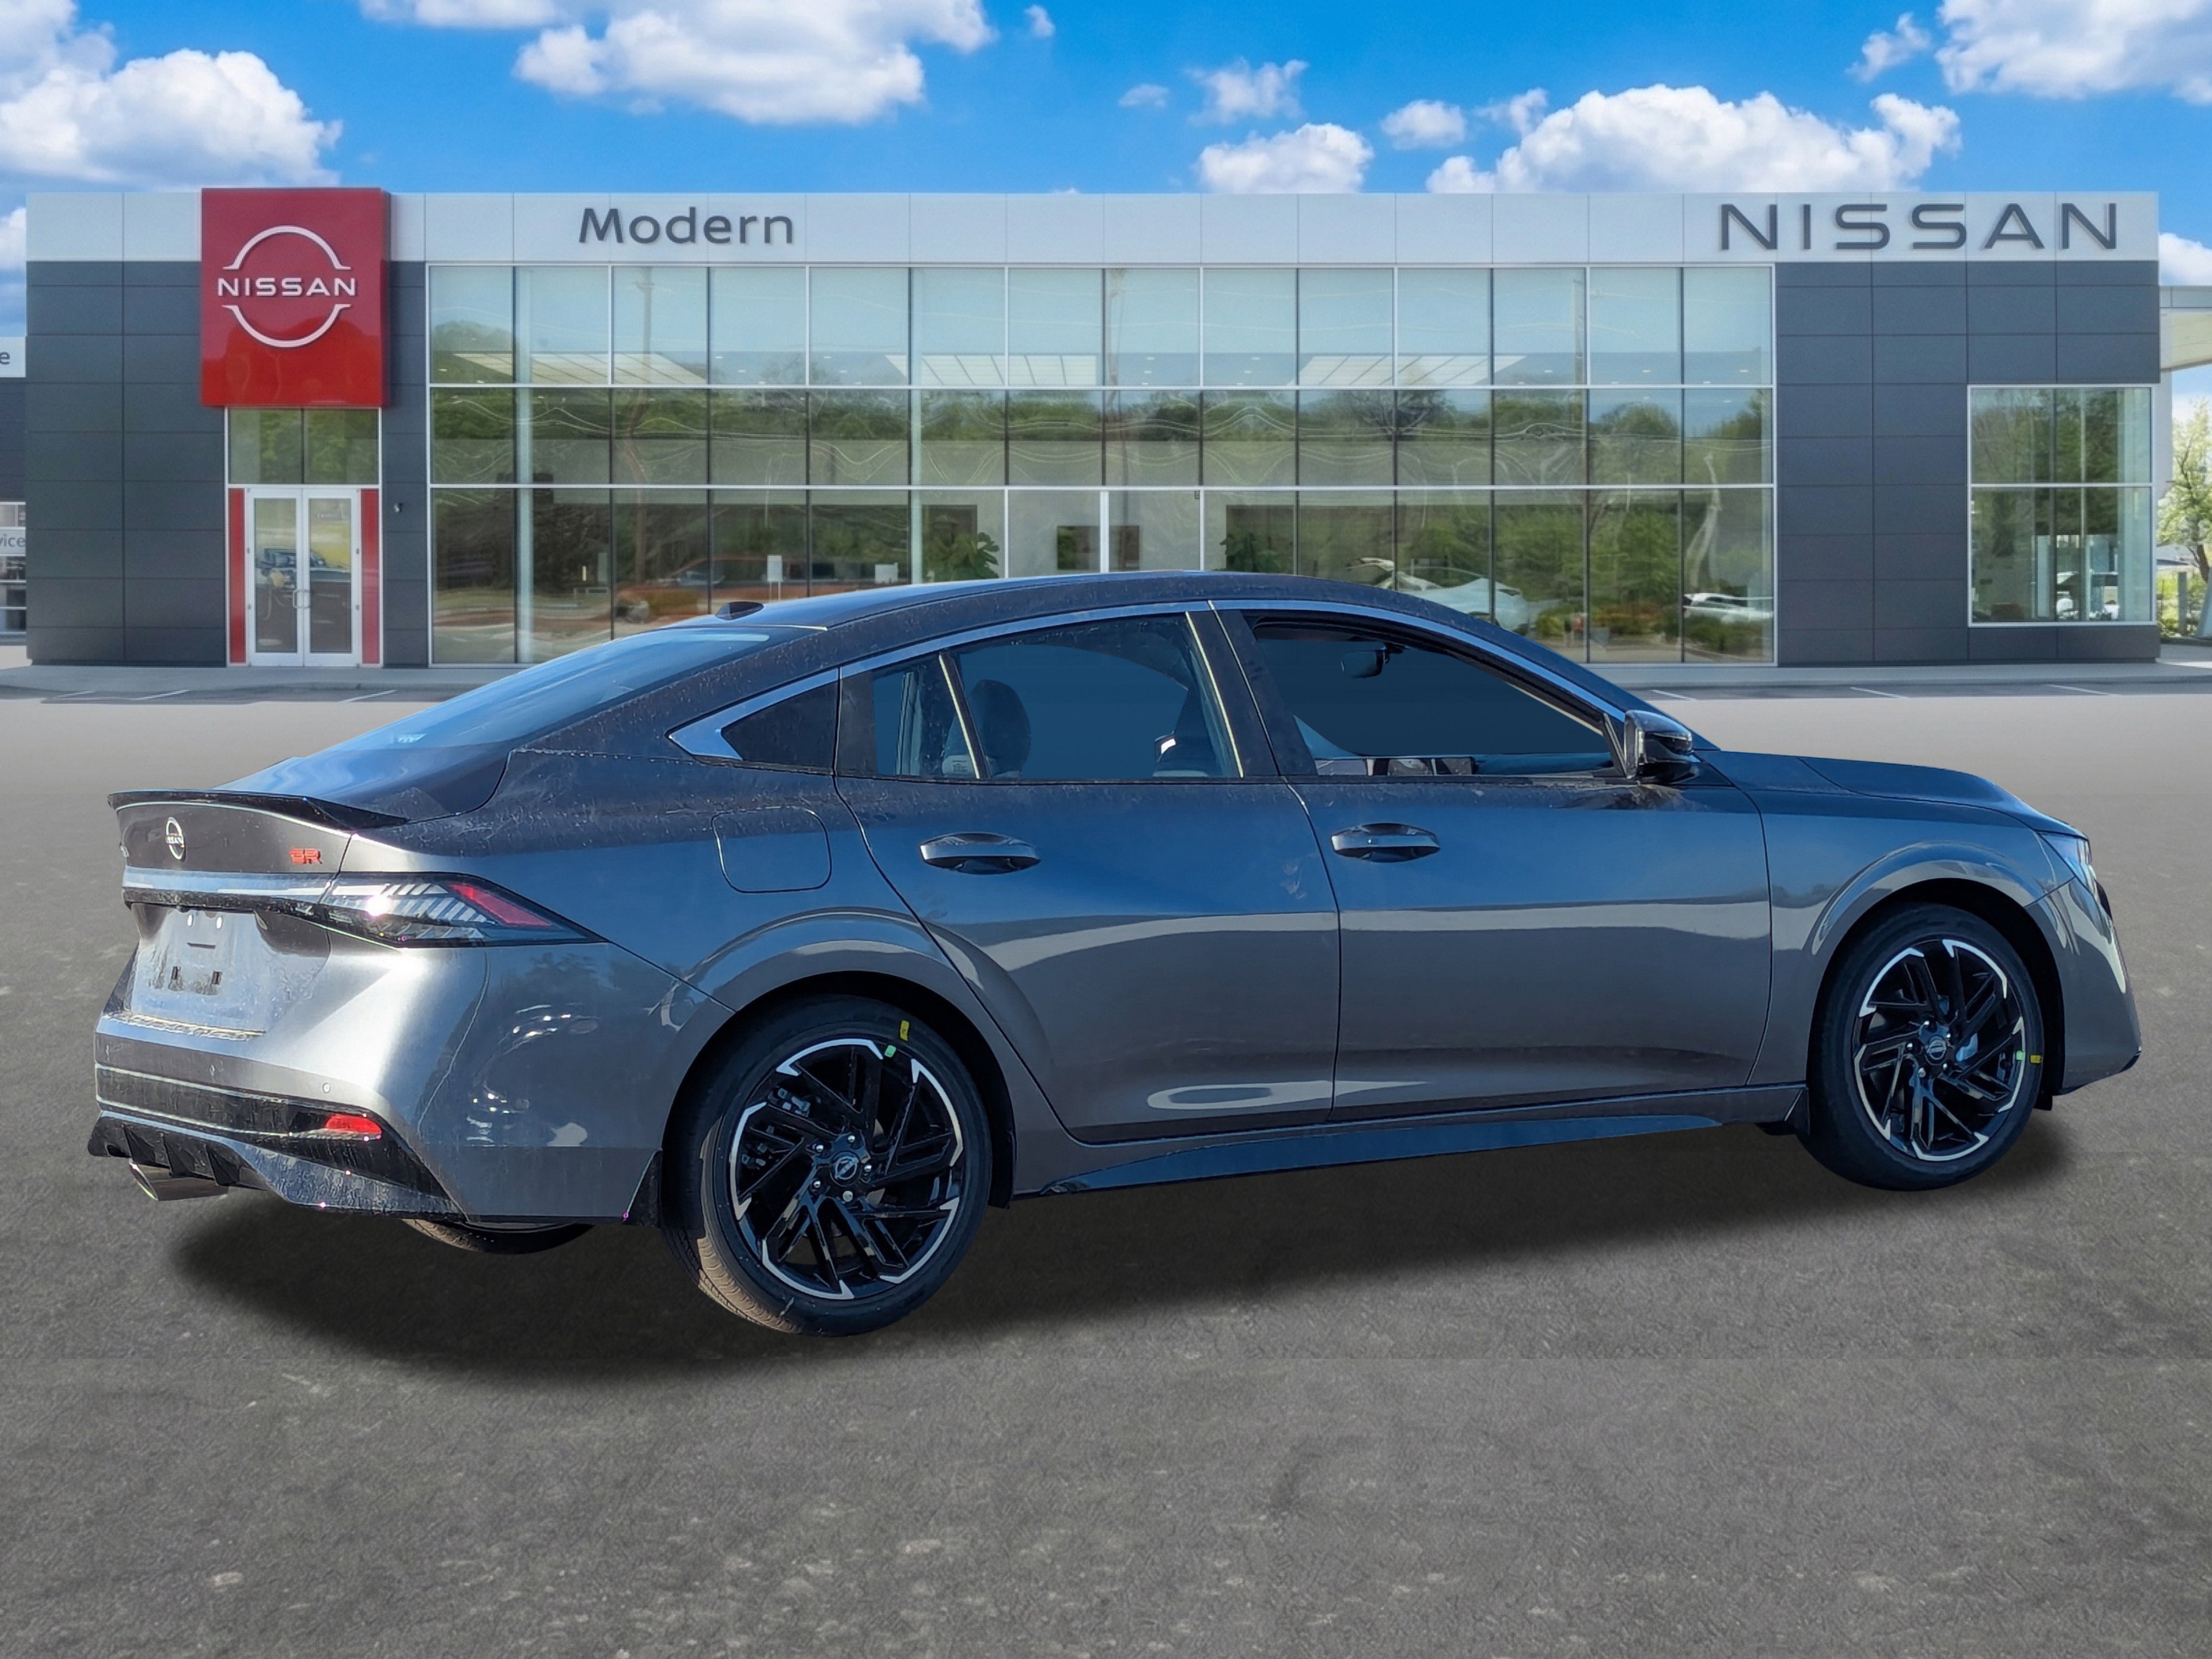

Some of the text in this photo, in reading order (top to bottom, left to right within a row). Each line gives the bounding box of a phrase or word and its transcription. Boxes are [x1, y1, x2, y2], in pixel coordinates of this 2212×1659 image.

[579, 207, 793, 244] Modern
[1720, 203, 2117, 250] NISSAN
[218, 278, 356, 297] NISSAN
